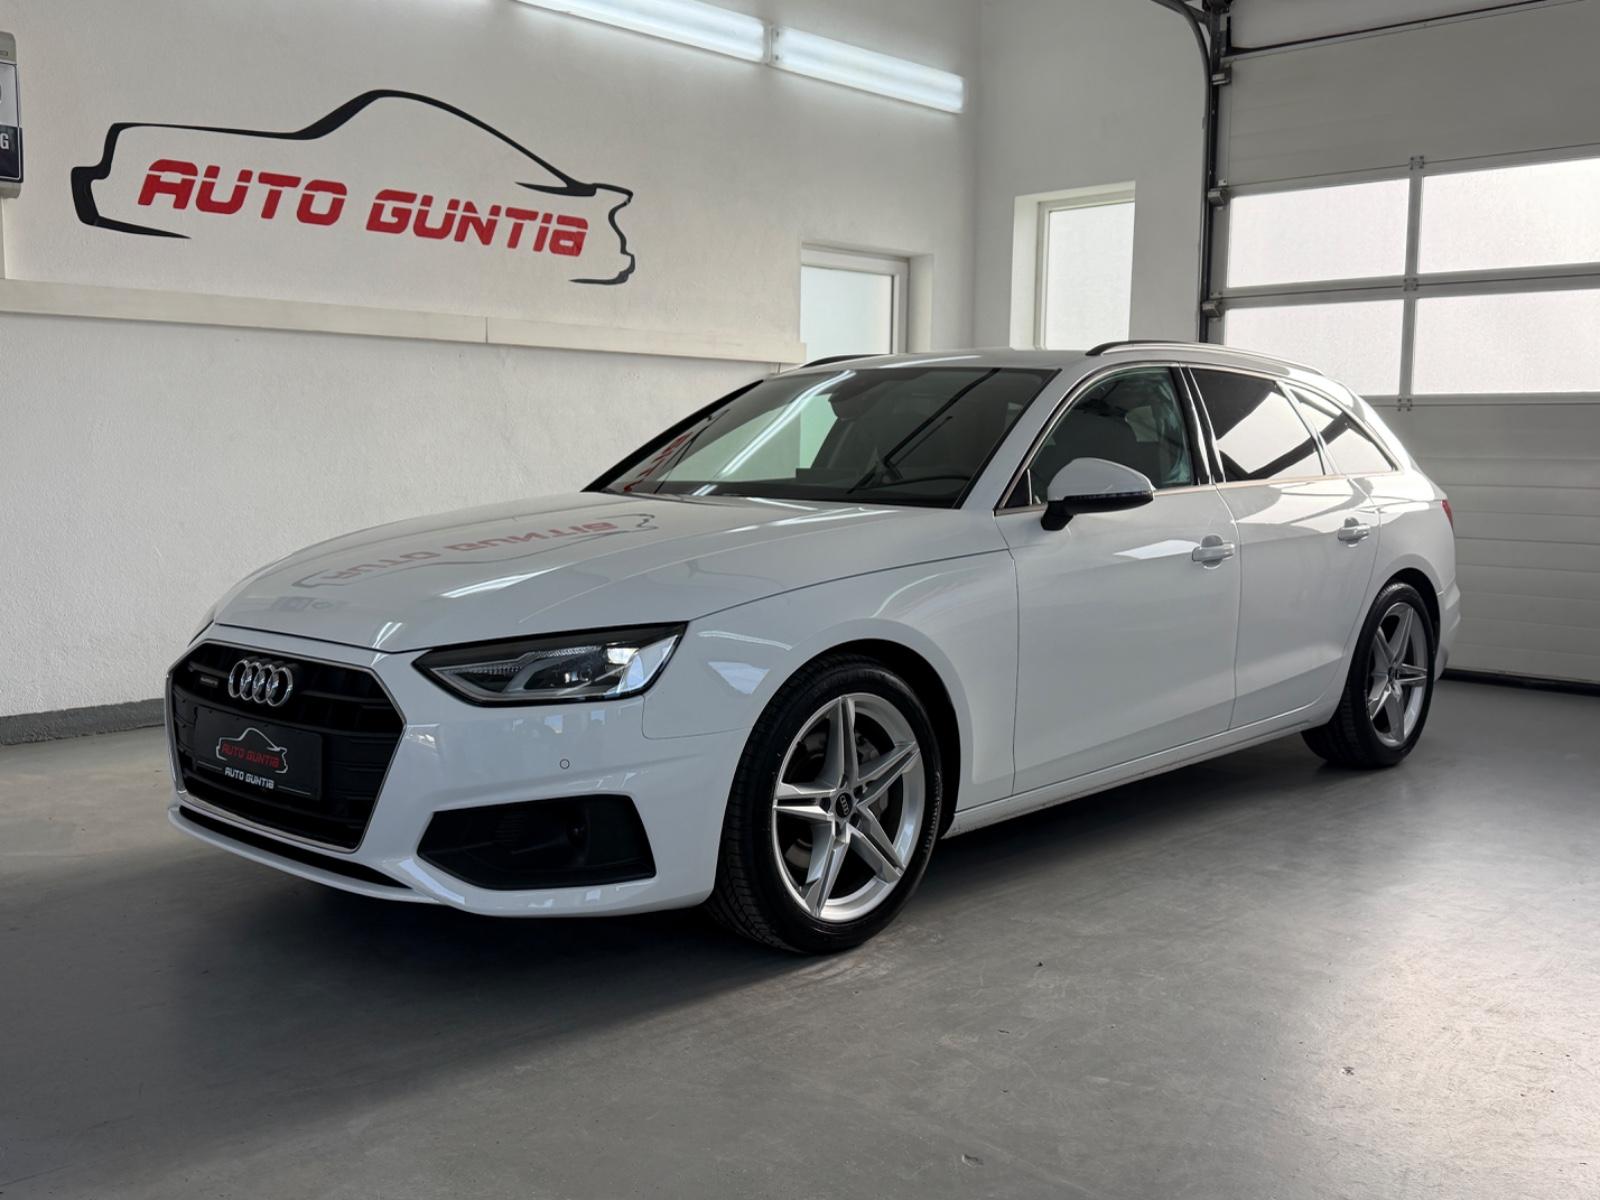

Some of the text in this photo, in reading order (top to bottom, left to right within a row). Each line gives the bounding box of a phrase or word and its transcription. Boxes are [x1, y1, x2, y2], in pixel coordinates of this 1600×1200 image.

[137, 158, 348, 227] AUTO
[222, 743, 245, 759] AUTO
[224, 766, 245, 781] AUTO
